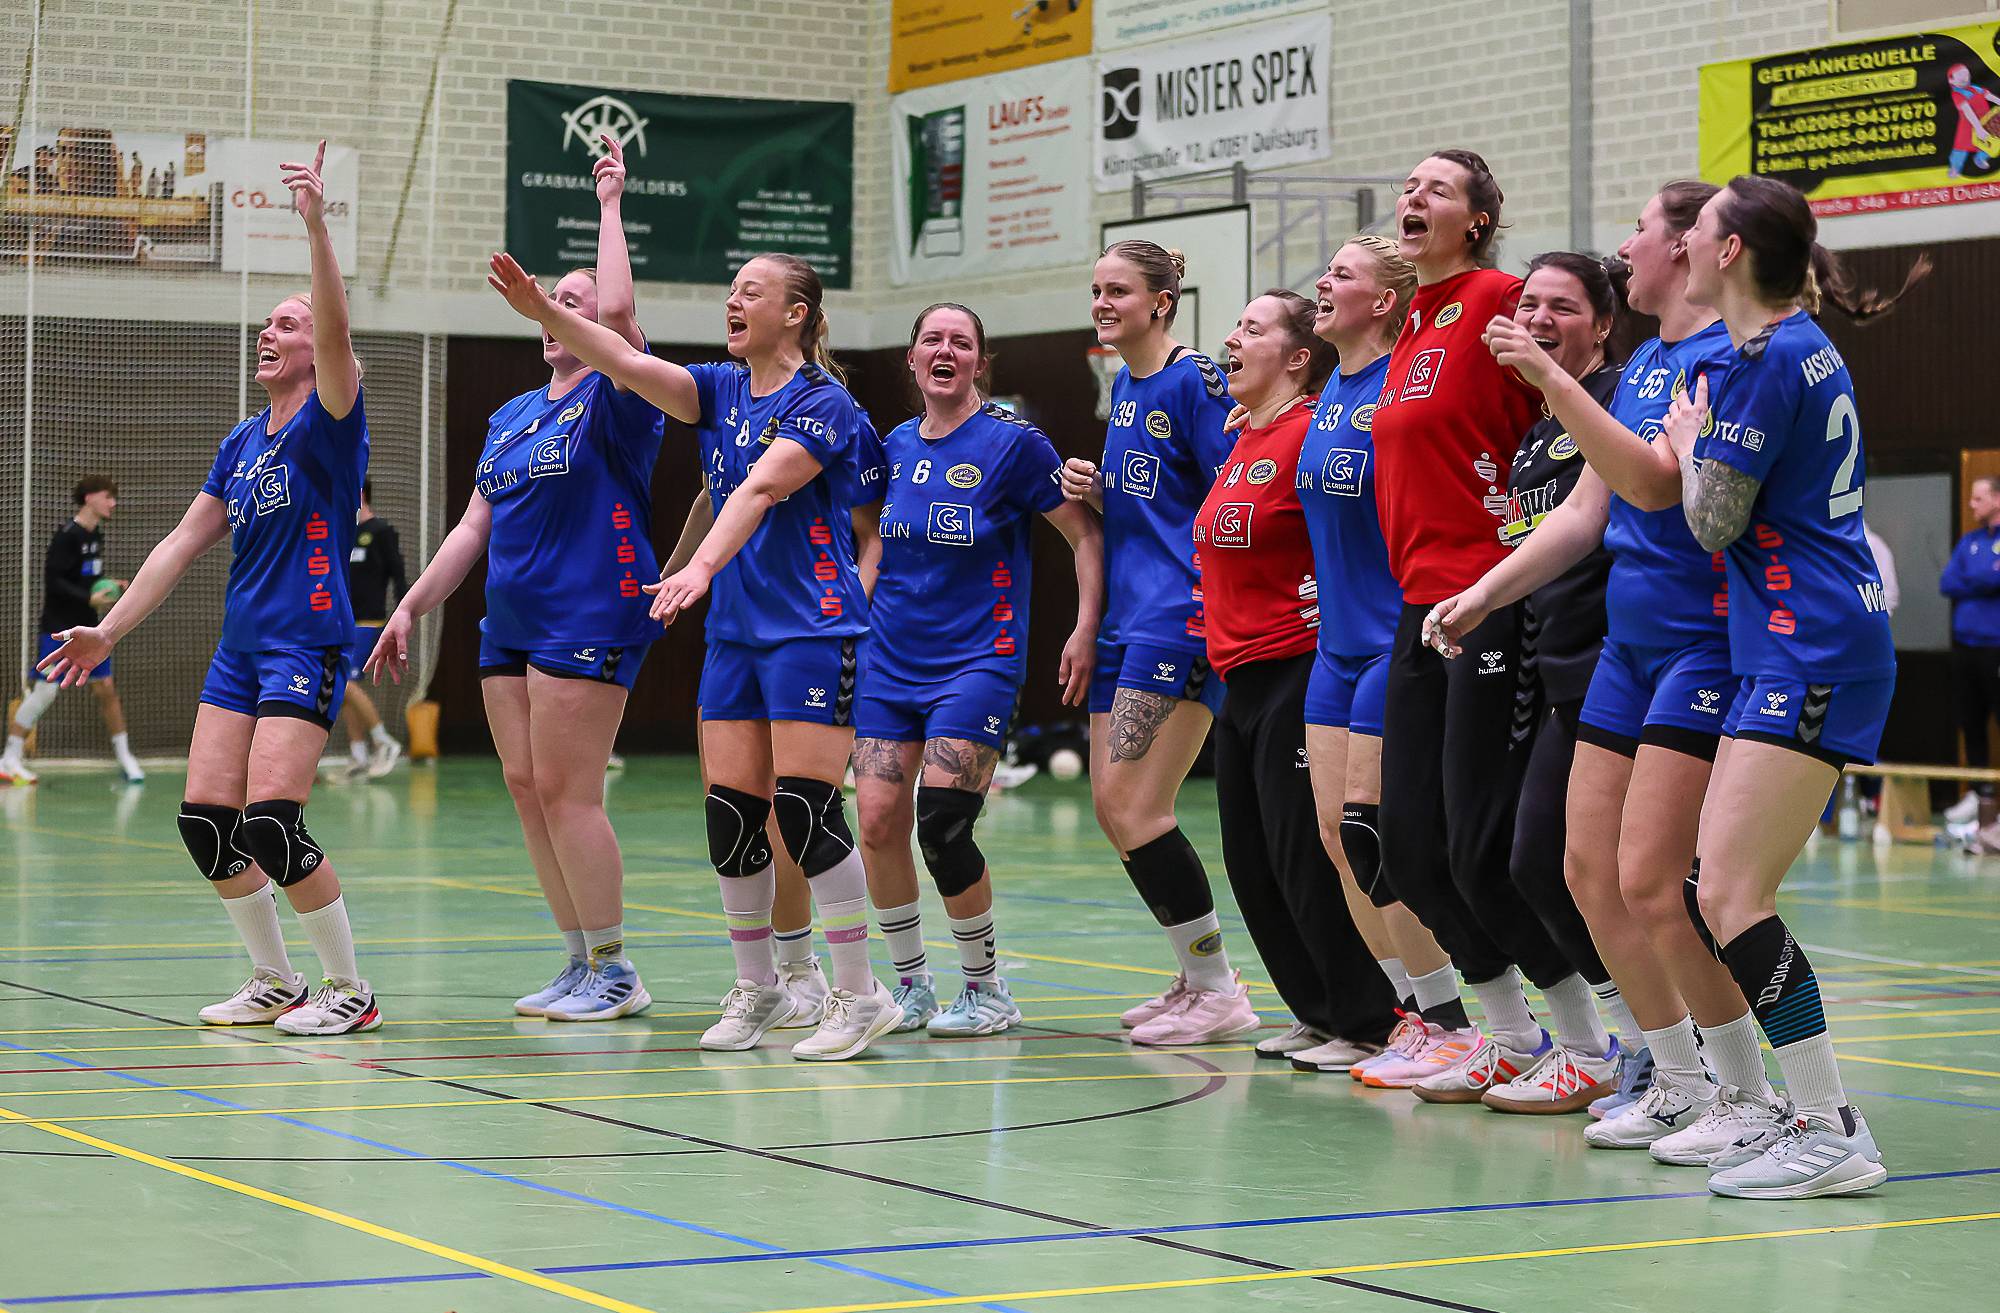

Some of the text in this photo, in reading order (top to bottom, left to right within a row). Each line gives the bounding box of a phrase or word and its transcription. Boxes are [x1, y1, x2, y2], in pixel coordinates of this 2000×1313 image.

[1155, 44, 1318, 123] MISTER SPEX
[989, 96, 1044, 131] LAUFS
[1250, 127, 1319, 153] Duisburg
[521, 171, 595, 192] GRABMAL
[1114, 400, 1137, 428] 39
[1317, 403, 1344, 432] 33
[796, 416, 824, 435] ITG
[1825, 392, 1863, 520] 2
[480, 468, 518, 496] OLLIN
[860, 466, 879, 486] ITG
[911, 459, 932, 485] 6
[941, 533, 967, 541] GRUPPE
[573, 652, 595, 662] hummel
[1153, 673, 1175, 683] hummel
[1478, 664, 1506, 675] hummel
[287, 684, 309, 696] hummel
[804, 699, 827, 708] hummel
[1690, 702, 1719, 715] hummel
[1759, 706, 1787, 718] hummel
